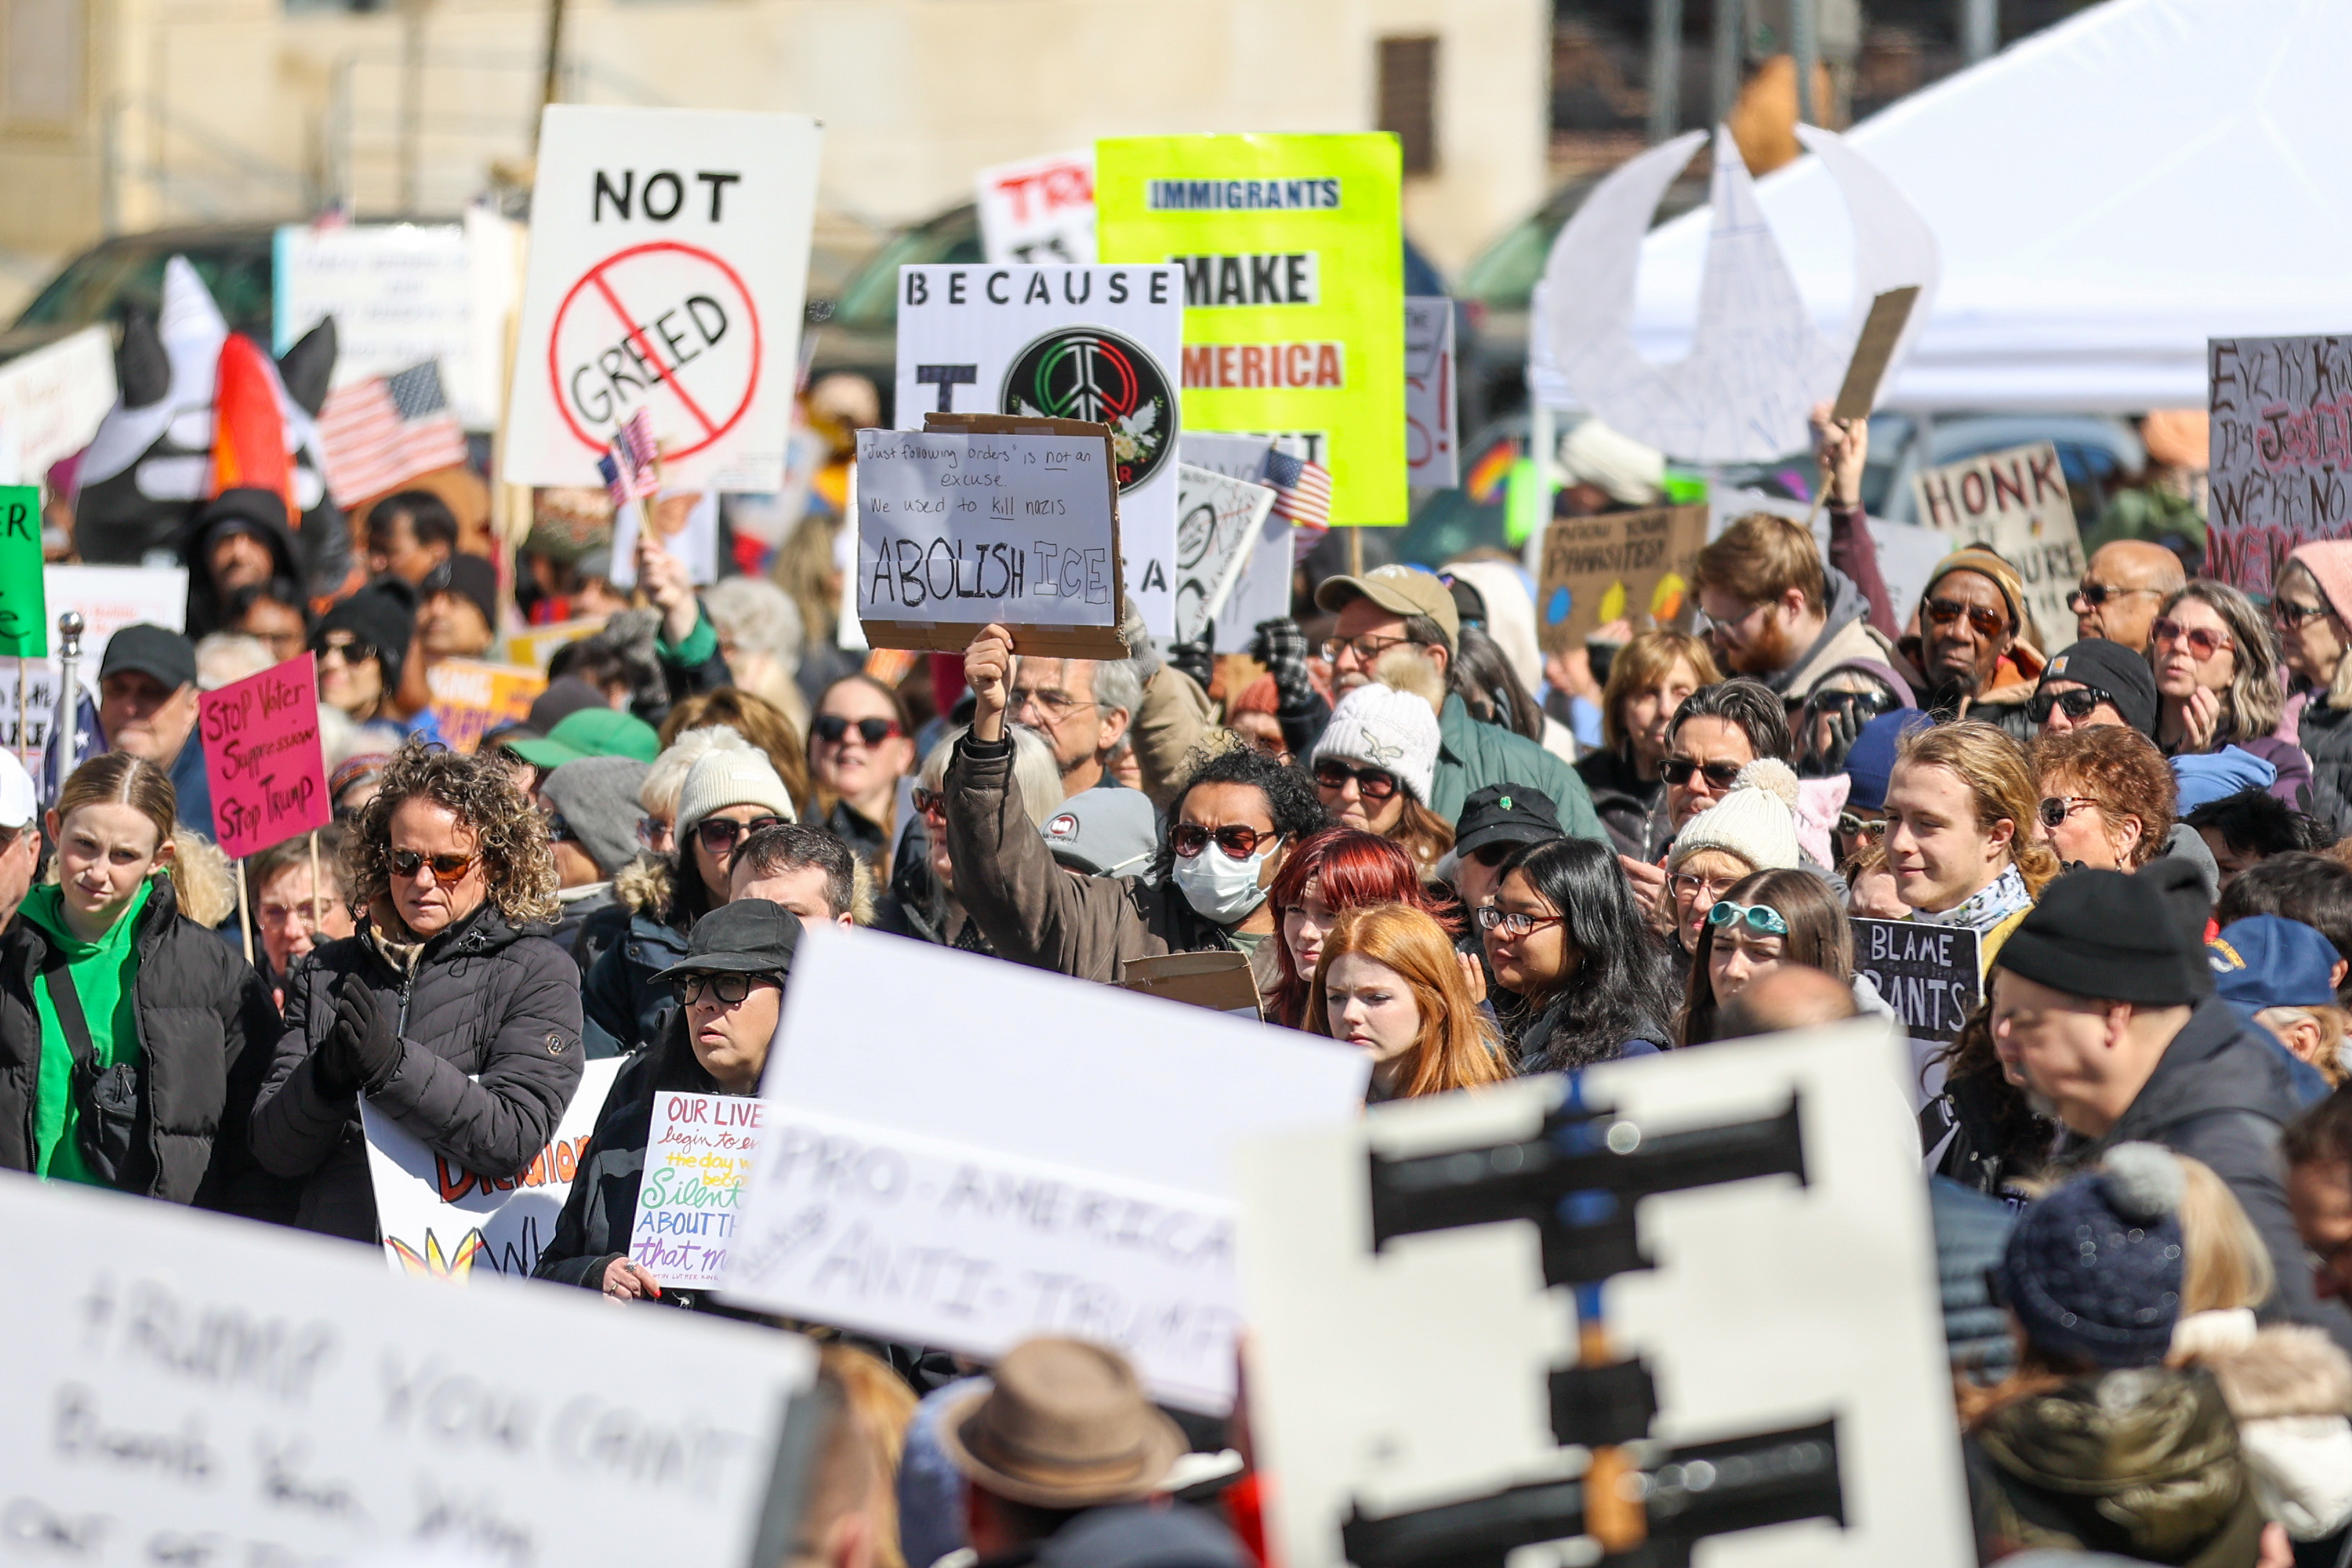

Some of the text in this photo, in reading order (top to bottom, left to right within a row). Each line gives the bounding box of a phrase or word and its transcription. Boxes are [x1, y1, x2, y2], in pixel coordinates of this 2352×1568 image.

[593, 169, 741, 223] NOT
[1152, 180, 1339, 209] IMMIGRANTS
[906, 271, 1169, 305] BECAUSE
[1173, 255, 1308, 305] MAKE
[572, 295, 728, 423] GREED
[901, 445, 957, 469] following
[1023, 452, 1036, 464] is
[1045, 450, 1072, 464] not
[1075, 452, 1091, 462] an
[941, 473, 1007, 488] excuse.
[1924, 448, 2067, 528] HONK
[0, 499, 32, 541] R
[870, 497, 891, 514] We
[904, 497, 945, 514] used
[957, 499, 978, 513] to
[871, 536, 1025, 608] ABOLISH
[257, 677, 308, 720] Voter
[1871, 924, 1955, 967] BLAME
[668, 1096, 708, 1123] OUR
[658, 1125, 711, 1154] begin
[713, 1131, 739, 1149] to
[666, 1152, 697, 1168] the
[699, 1152, 735, 1176] day
[641, 1167, 748, 1210] Silent
[636, 1211, 716, 1236] ABOUT
[633, 1236, 702, 1271] that
